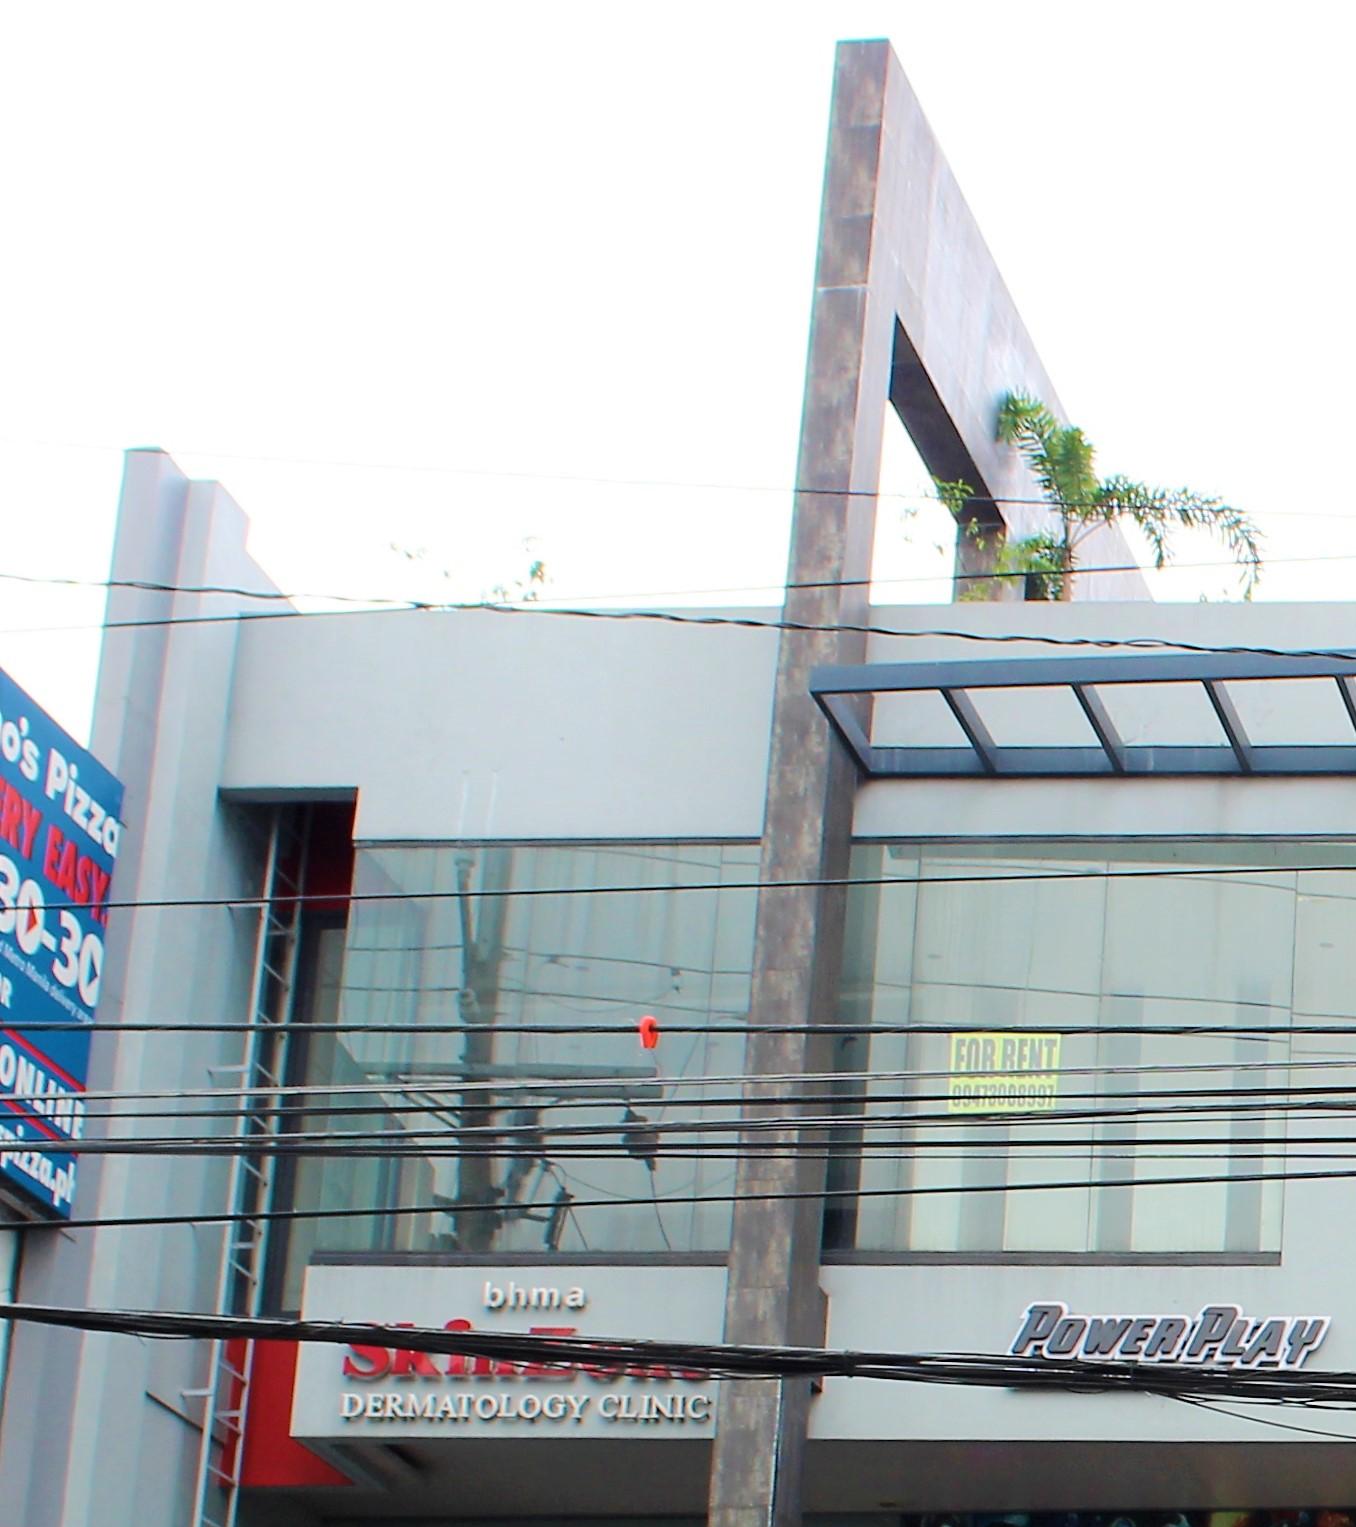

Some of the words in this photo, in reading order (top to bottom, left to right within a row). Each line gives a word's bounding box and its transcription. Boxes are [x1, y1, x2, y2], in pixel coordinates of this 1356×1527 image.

[45, 748, 120, 858] Pizza
[955, 1038, 996, 1075] FOR
[1001, 1038, 1058, 1074] RENT
[482, 1281, 587, 1310] bhma
[340, 1393, 589, 1423] DERMATOLOGY
[597, 1394, 711, 1422] CLINIC
